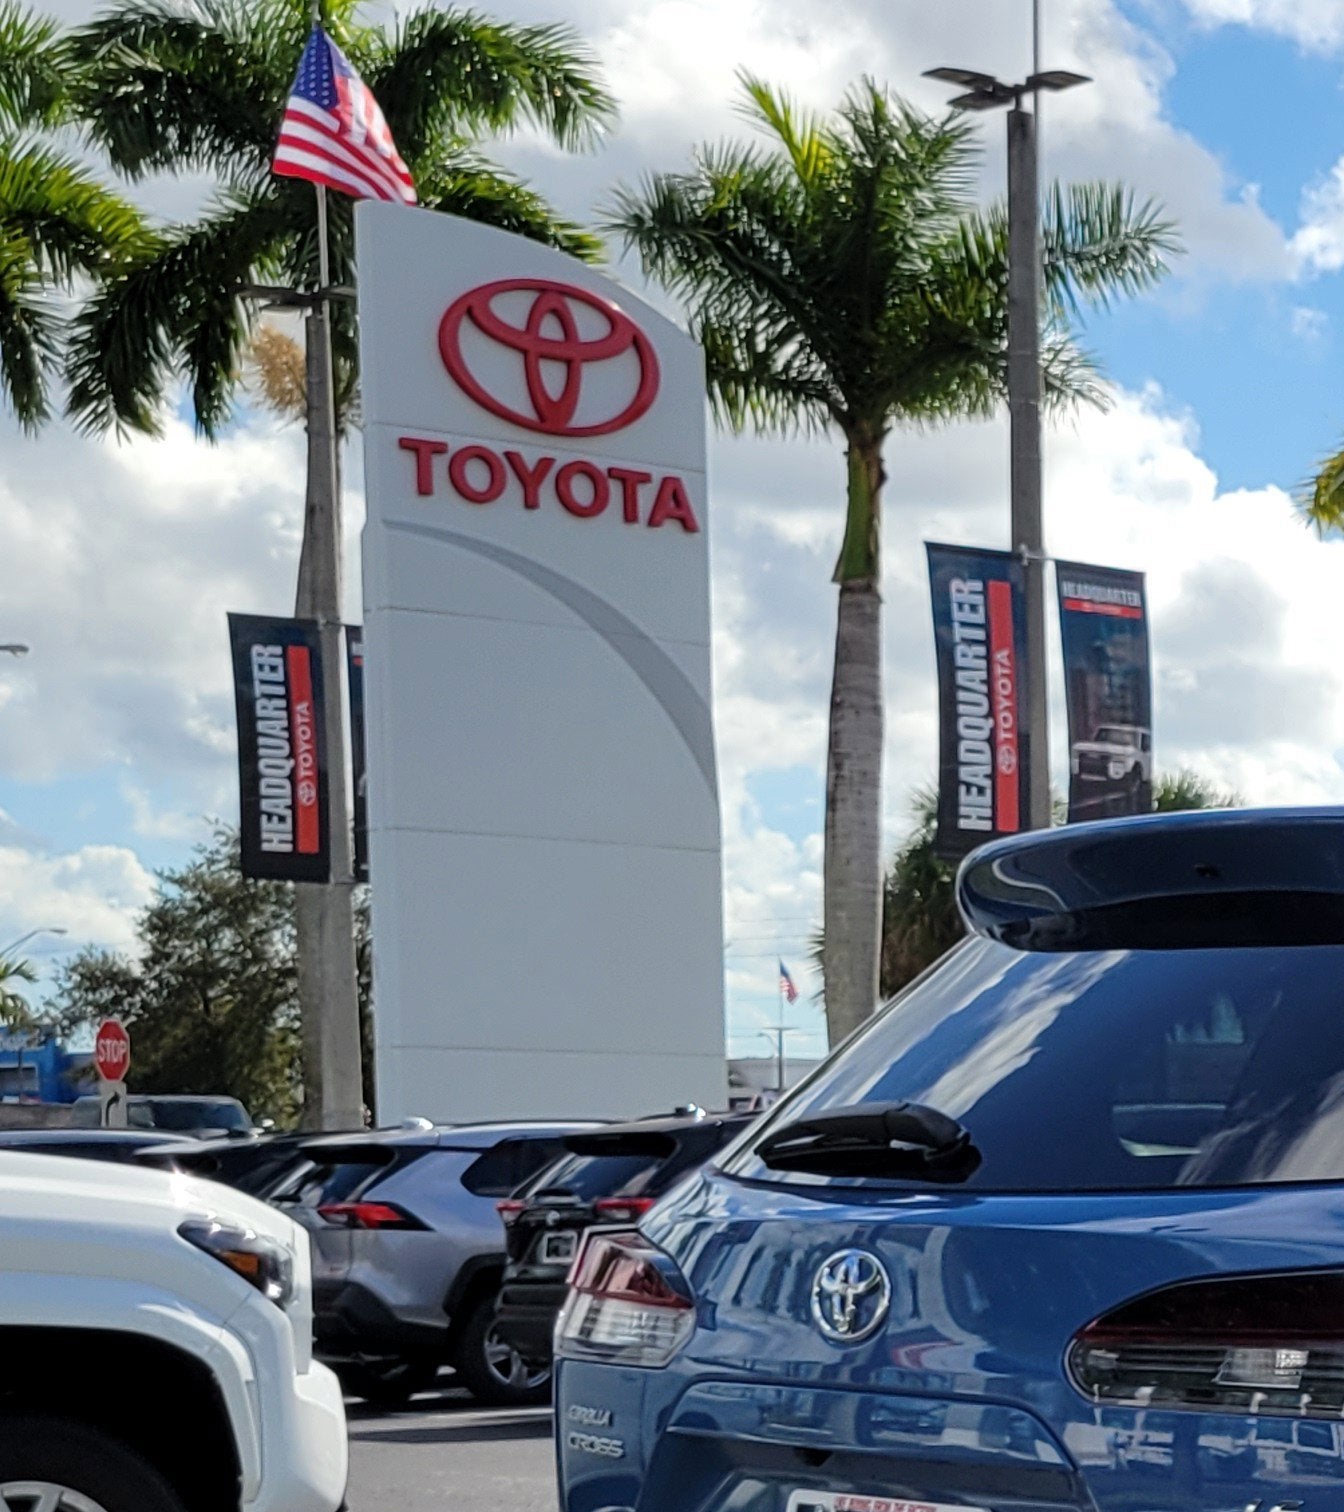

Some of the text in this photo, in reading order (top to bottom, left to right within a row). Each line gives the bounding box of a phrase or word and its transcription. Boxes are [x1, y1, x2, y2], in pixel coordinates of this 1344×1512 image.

[398, 437, 699, 533] TOYOTA
[951, 578, 994, 831] HEADQUARTER
[998, 649, 1015, 736] TOYOTA
[251, 644, 295, 853] HEADQUARTER
[297, 702, 315, 777] TOYOTA
[99, 1039, 128, 1063] STOP
[569, 1432, 624, 1458] CROSS
